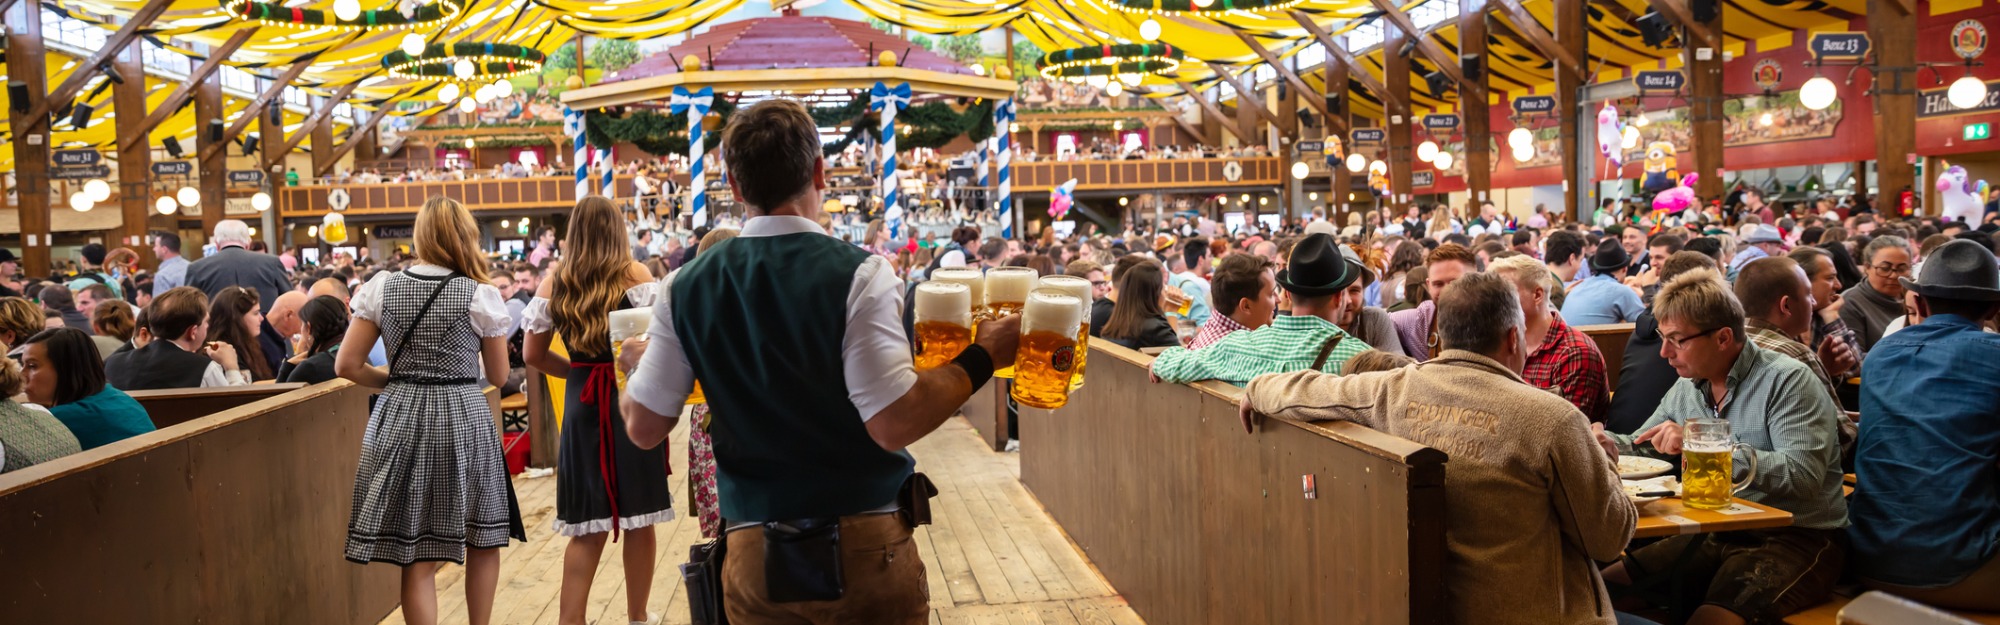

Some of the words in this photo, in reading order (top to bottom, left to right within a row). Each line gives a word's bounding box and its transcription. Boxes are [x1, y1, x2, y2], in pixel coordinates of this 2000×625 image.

[1822, 39, 1846, 51] Boxe
[1847, 38, 1858, 53] 13
[1645, 75, 1664, 86] Boxe
[1665, 75, 1676, 88] 14
[1538, 99, 1549, 109] 20
